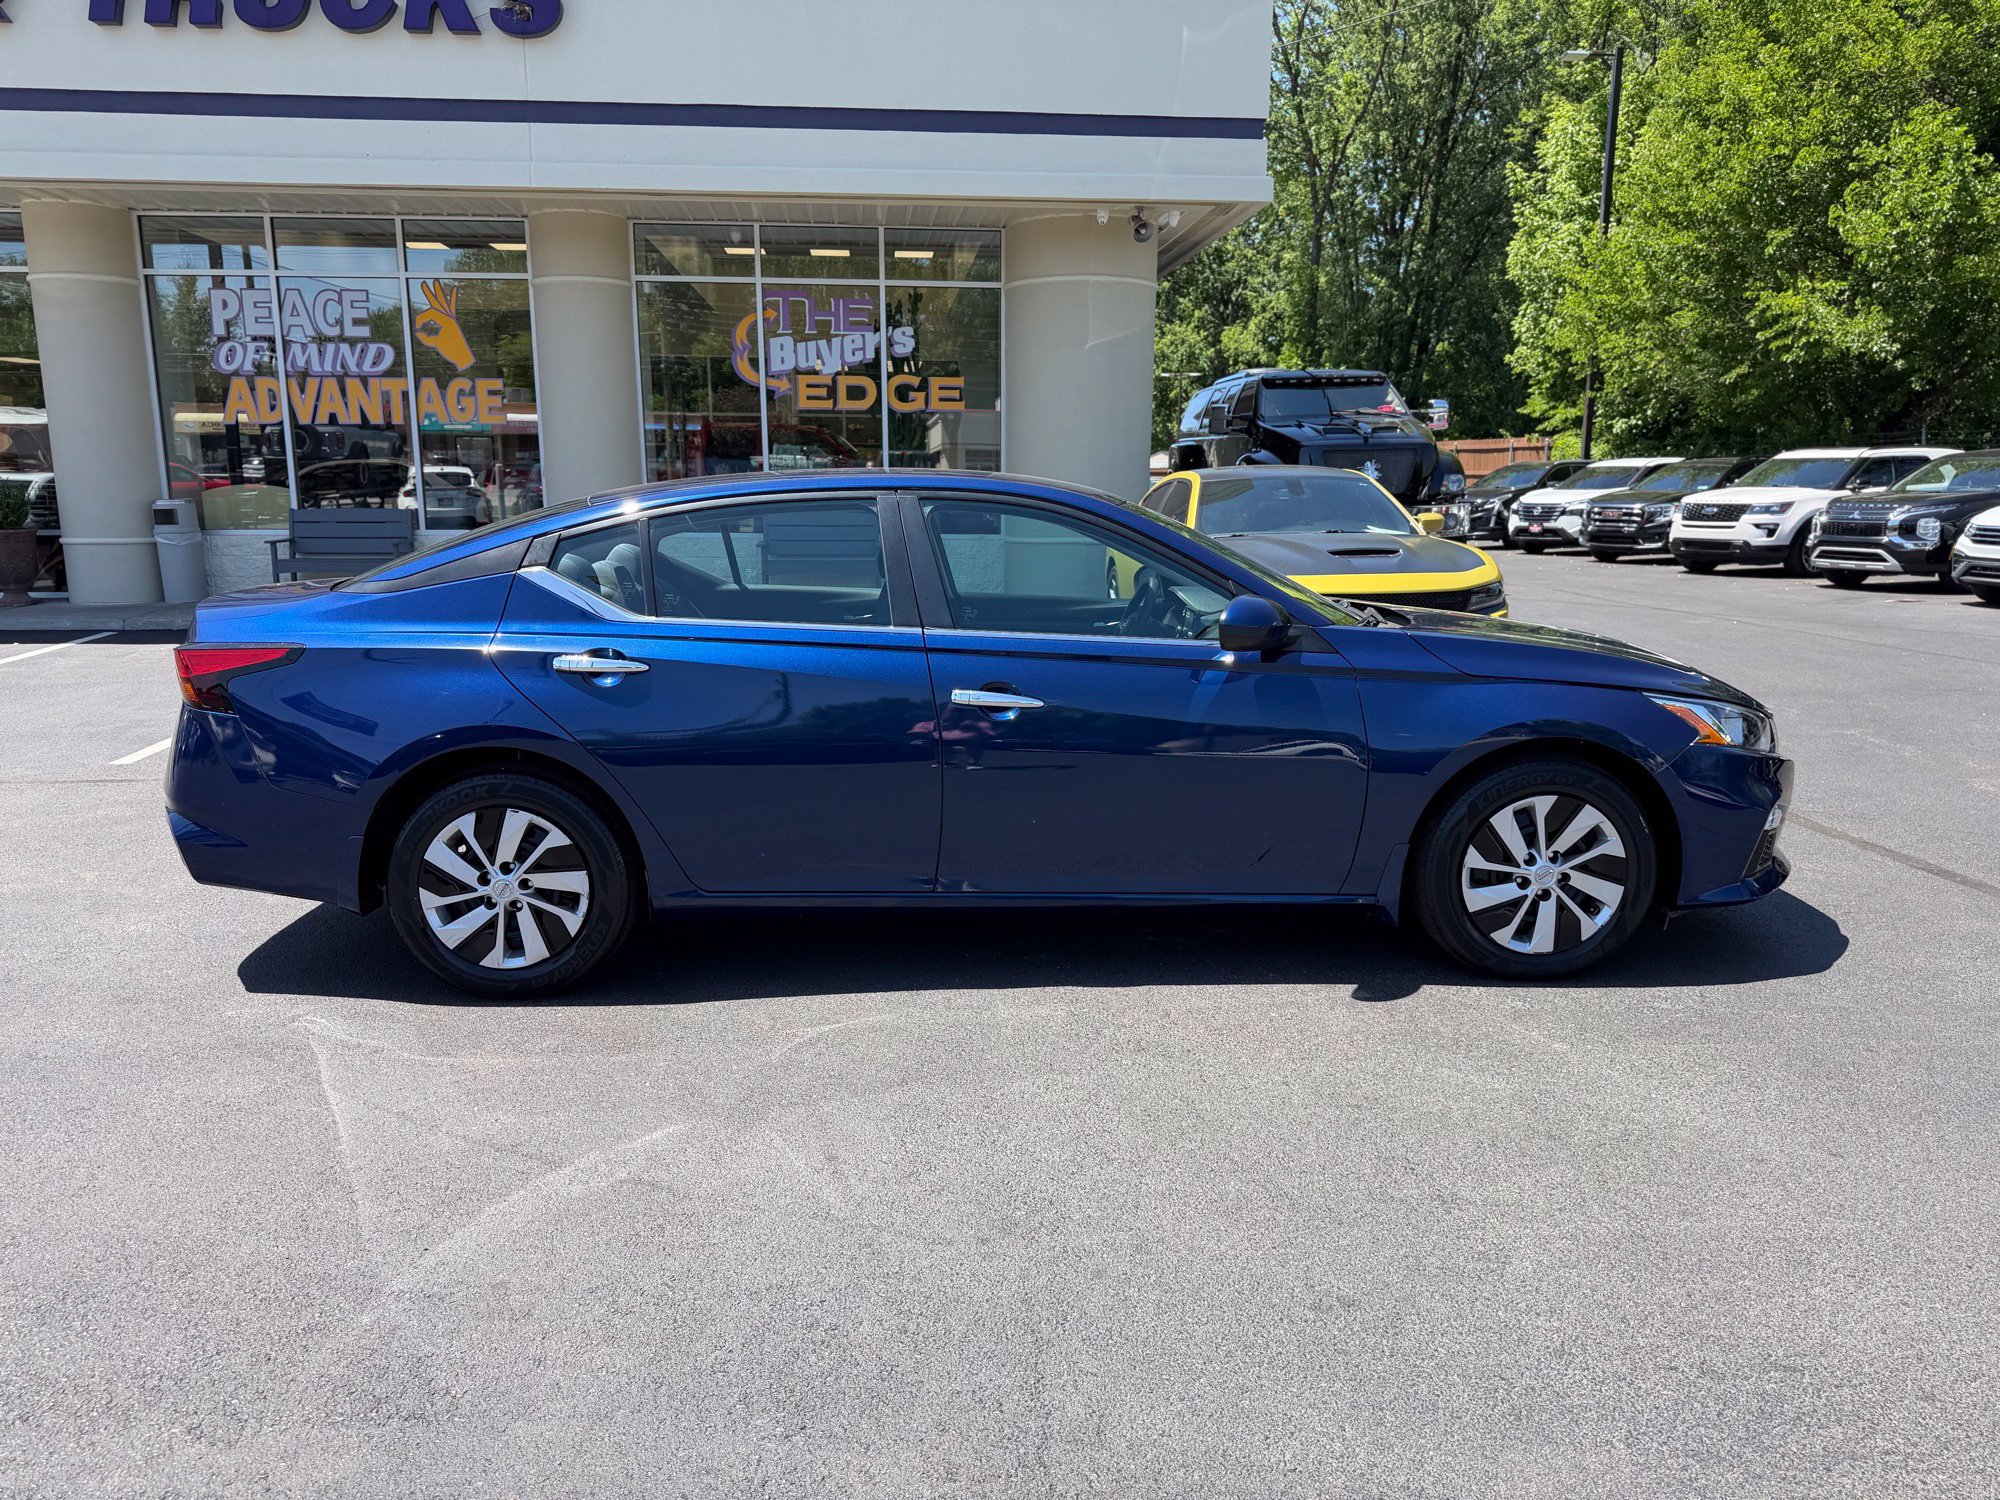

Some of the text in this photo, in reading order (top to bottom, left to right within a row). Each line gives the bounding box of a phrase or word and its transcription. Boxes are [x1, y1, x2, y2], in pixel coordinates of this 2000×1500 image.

[208, 287, 372, 337] PEACE
[763, 289, 874, 335] THE
[214, 341, 396, 376] OF MIND
[768, 326, 916, 376] Buyer's
[223, 376, 508, 425] ADVANTAGE
[796, 374, 966, 413] EDGE
